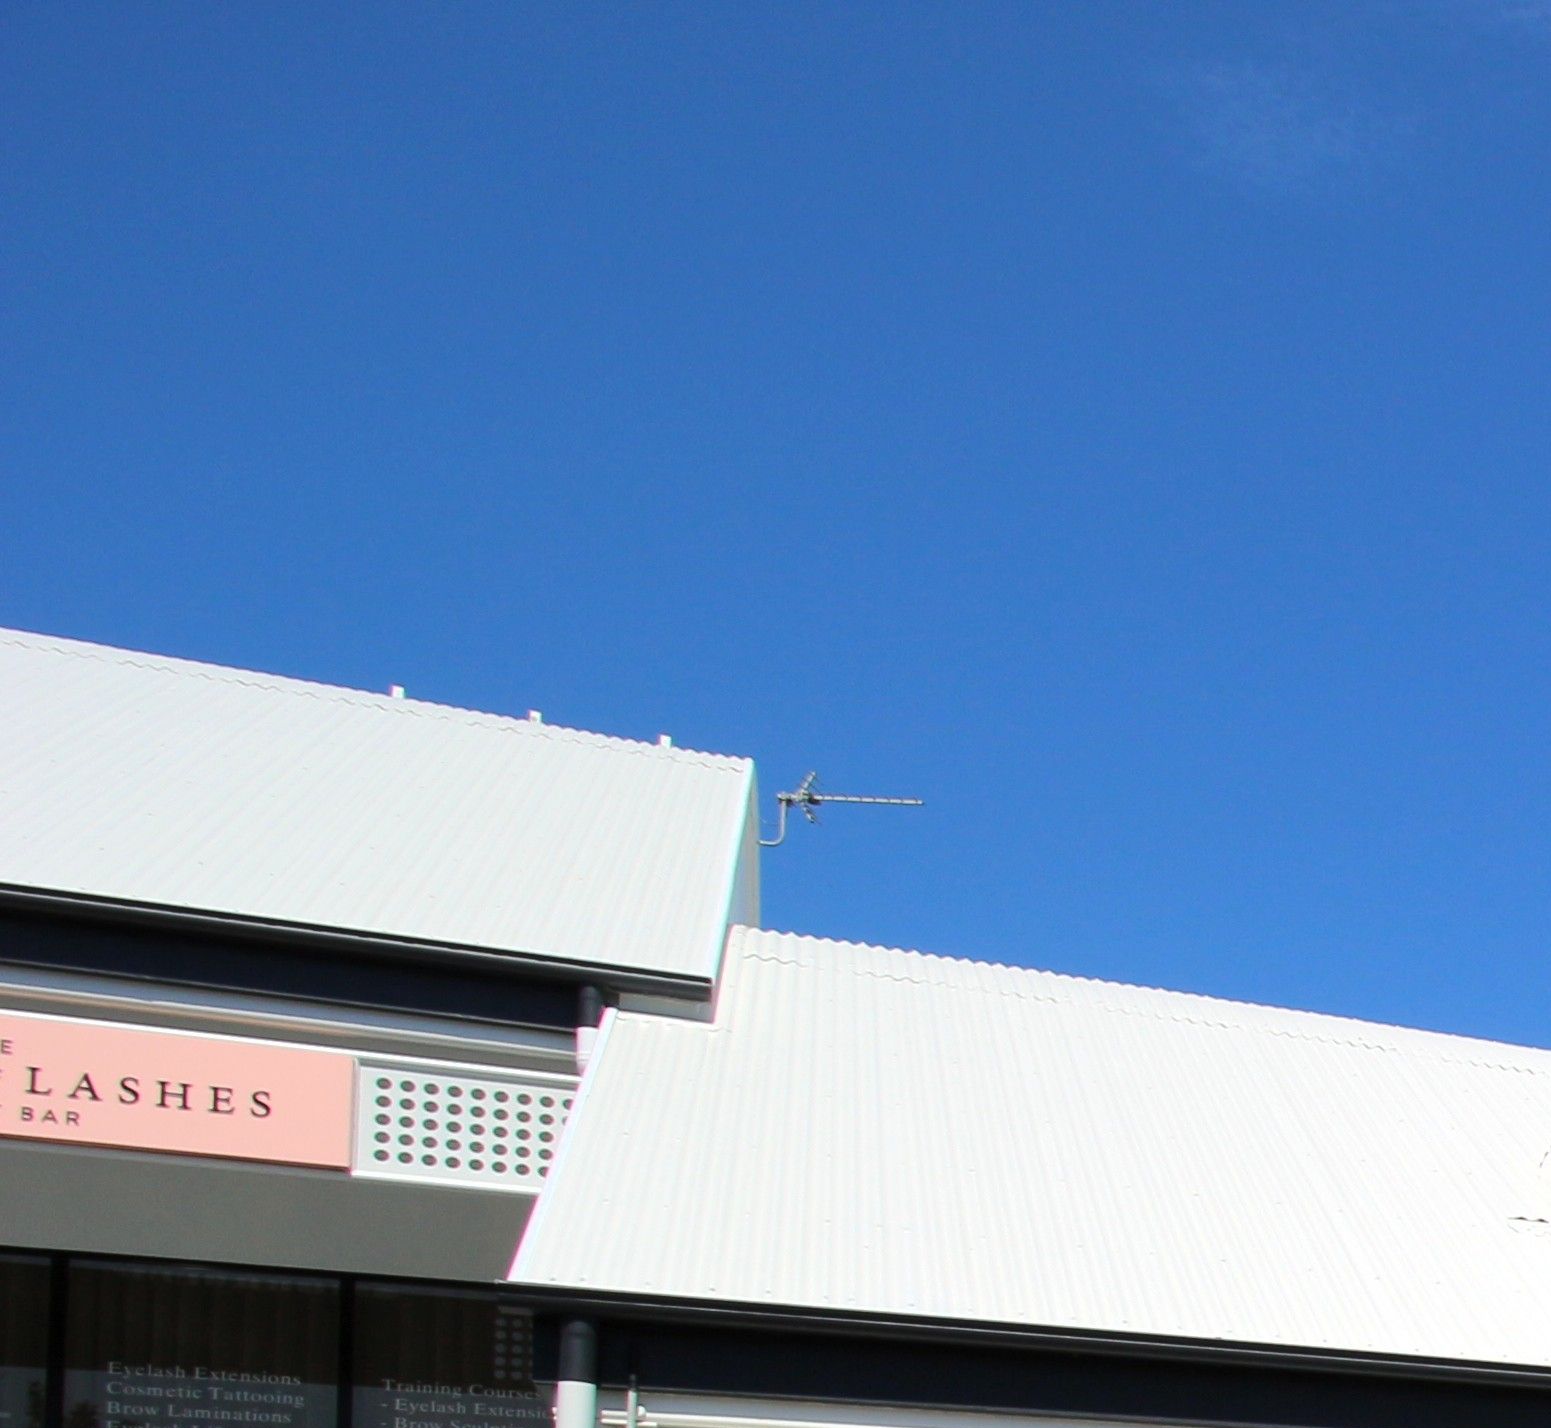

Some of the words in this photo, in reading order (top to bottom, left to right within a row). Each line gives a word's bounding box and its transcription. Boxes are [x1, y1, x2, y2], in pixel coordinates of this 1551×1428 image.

[25, 1066, 272, 1119] LASHES
[21, 1106, 81, 1126] BAR
[106, 1361, 186, 1380] Eyelash
[193, 1367, 301, 1386] Extensions
[105, 1381, 201, 1399] Cosmetic
[208, 1387, 305, 1407] Tattooing
[382, 1378, 462, 1398] Training
[105, 1401, 159, 1416] Brow
[168, 1404, 292, 1424] Laminations
[394, 1398, 466, 1415] Eyelash
